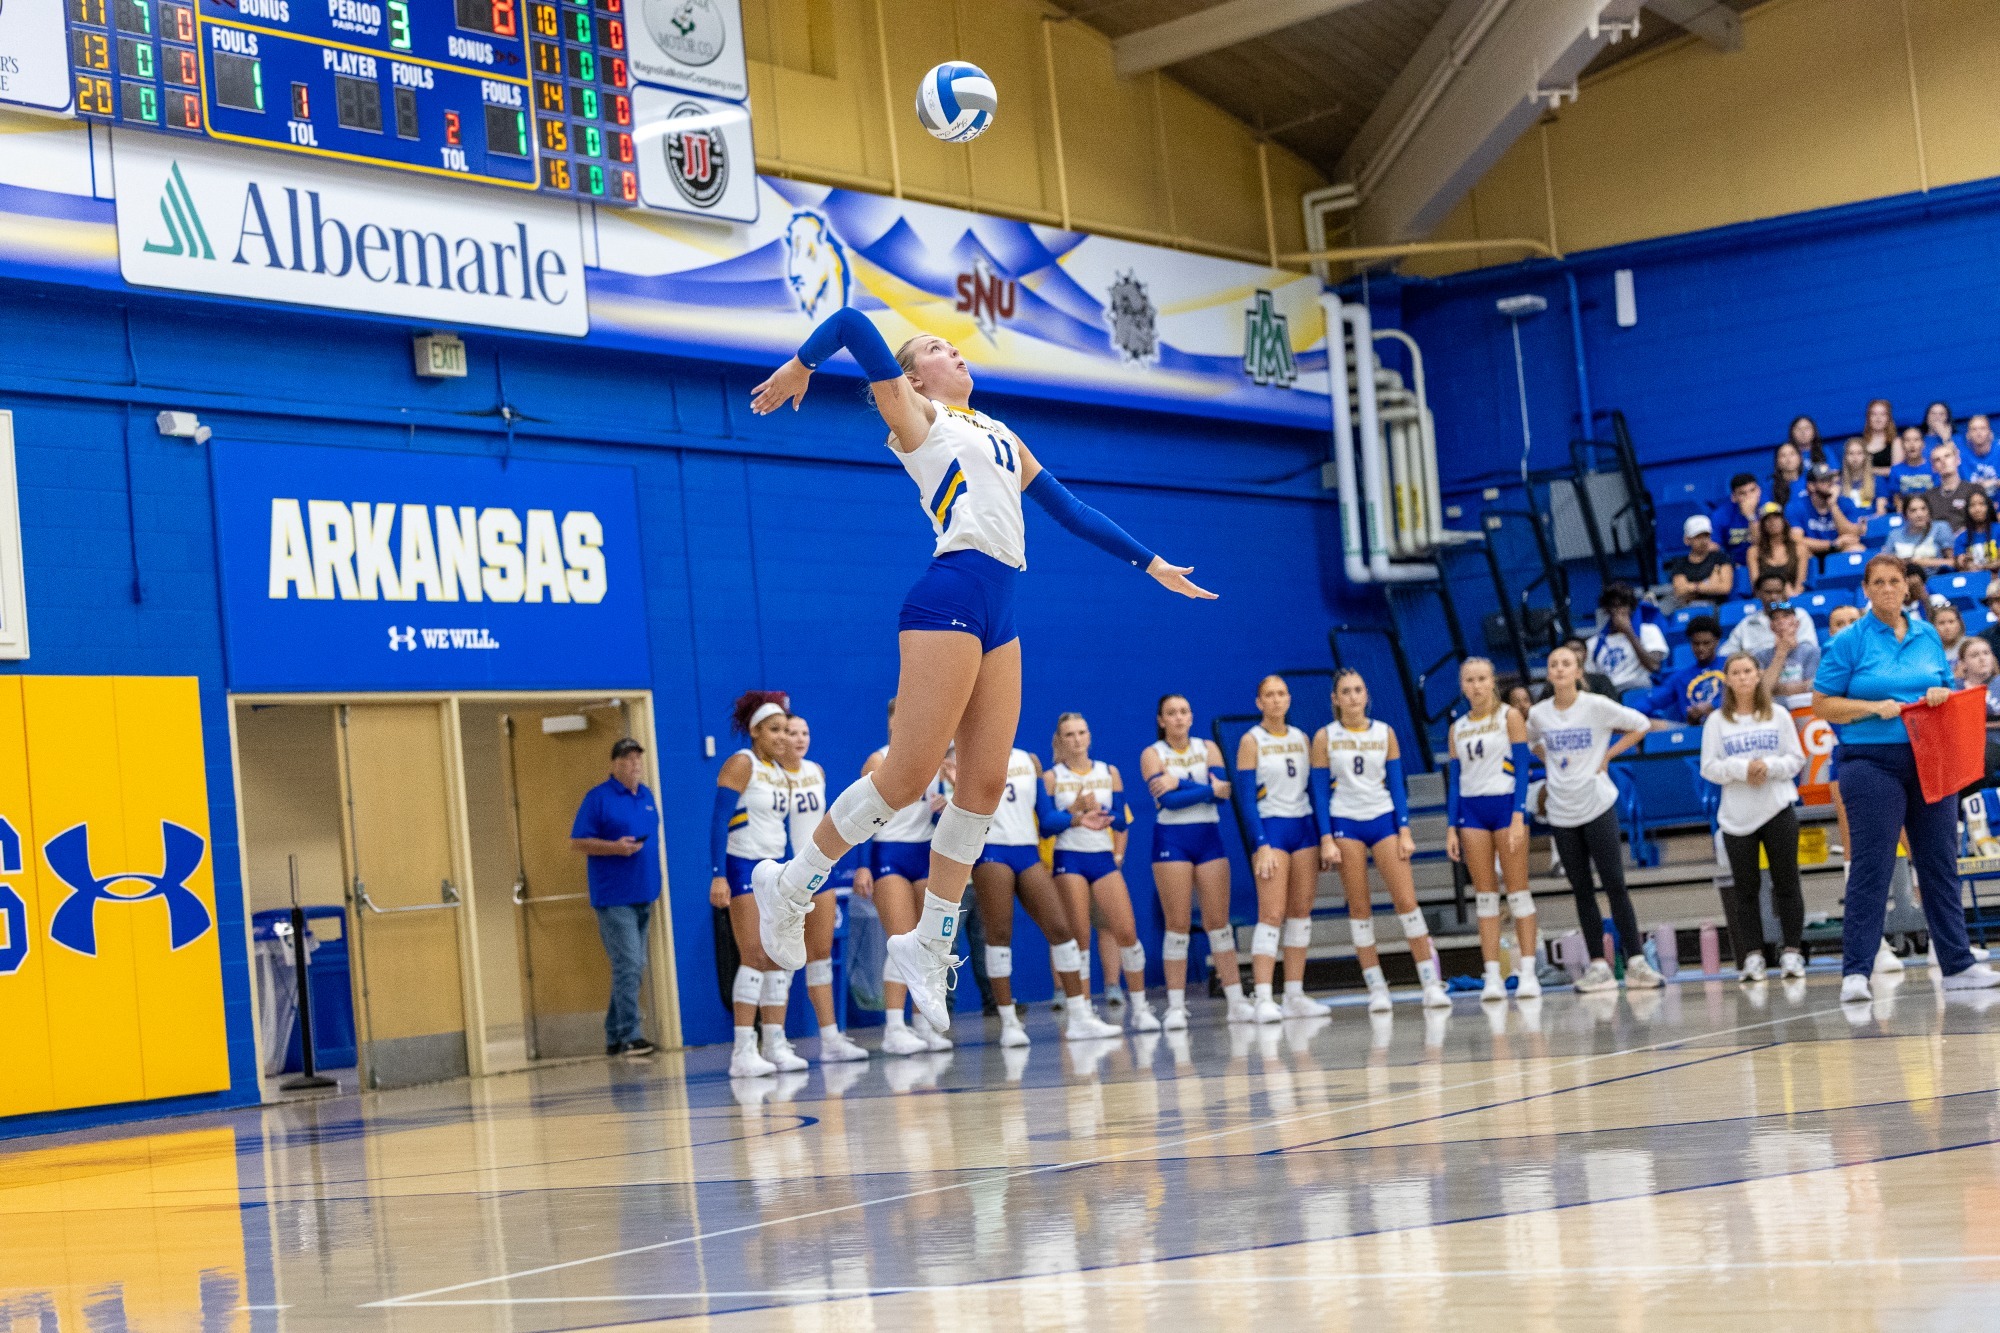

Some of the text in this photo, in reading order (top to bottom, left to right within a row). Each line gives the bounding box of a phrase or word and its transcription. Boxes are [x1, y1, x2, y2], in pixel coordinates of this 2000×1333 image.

[177, 8, 193, 42] 0
[328, 0, 382, 26] PERIOD
[388, 0, 411, 50] 3
[537, 5, 625, 51] 10 0 0
[211, 27, 259, 56] FOULS
[448, 35, 494, 65] BONUS
[84, 35, 197, 85] 13 0 0
[323, 48, 378, 79] PLAYER
[391, 62, 435, 90] FOULS
[540, 43, 628, 88] 11 0 0
[252, 61, 264, 110] 1
[301, 86, 309, 118] 1
[481, 79, 522, 107] FOULS
[77, 77, 200, 129] 20 0 0
[543, 81, 631, 126] 14 0 0
[287, 120, 318, 147] TOL
[445, 112, 461, 145] 2
[516, 111, 528, 156] 1
[546, 120, 567, 151] 15
[586, 126, 601, 157] 0
[619, 132, 634, 163] 0
[440, 147, 470, 172] TOL
[681, 132, 711, 182] JJ
[550, 159, 571, 190] 16
[589, 164, 605, 196] 0
[622, 169, 638, 201] 0
[231, 182, 569, 306] Albemarle
[956, 270, 1015, 324] SNU
[431, 341, 461, 370] EXIT
[986, 433, 1016, 474] 11
[269, 498, 608, 604] ARKANSAS
[421, 628, 500, 649] WE WILL.
[1466, 739, 1484, 761] 14
[1803, 717, 1839, 756] G
[1286, 758, 1297, 778] 6
[1353, 755, 1365, 775] 8
[772, 791, 787, 812] 12
[795, 791, 819, 813] 20
